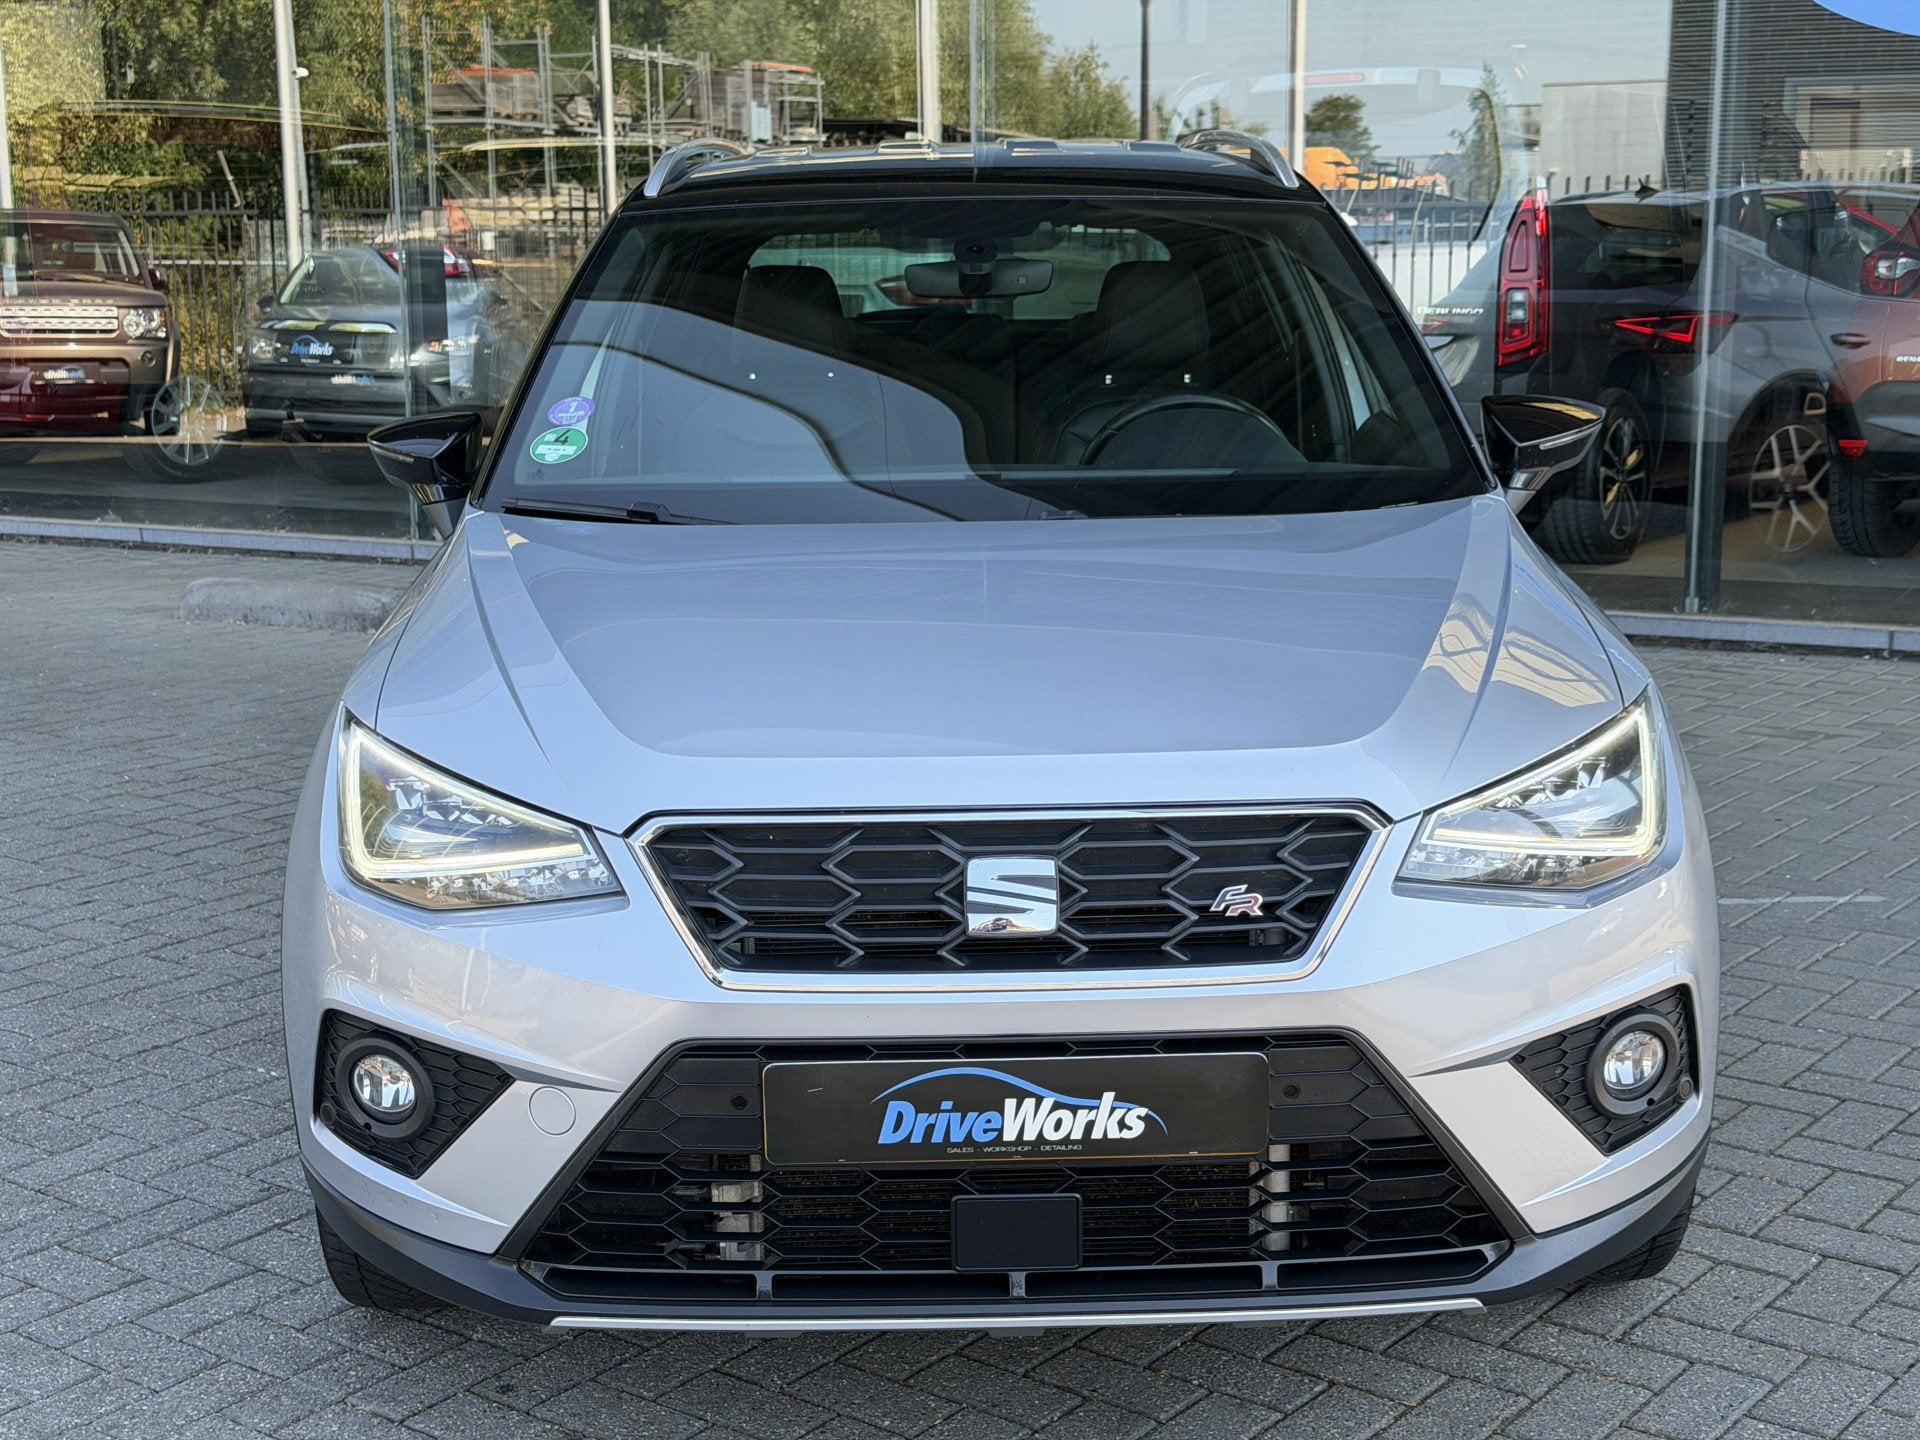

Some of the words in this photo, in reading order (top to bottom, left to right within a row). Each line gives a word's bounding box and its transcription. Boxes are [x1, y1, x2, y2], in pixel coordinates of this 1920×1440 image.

[553, 429, 572, 445] 4
[1209, 884, 1264, 916] FR
[877, 1091, 1149, 1145] DriveWorks
[983, 1145, 1032, 1153] WORKSHOP
